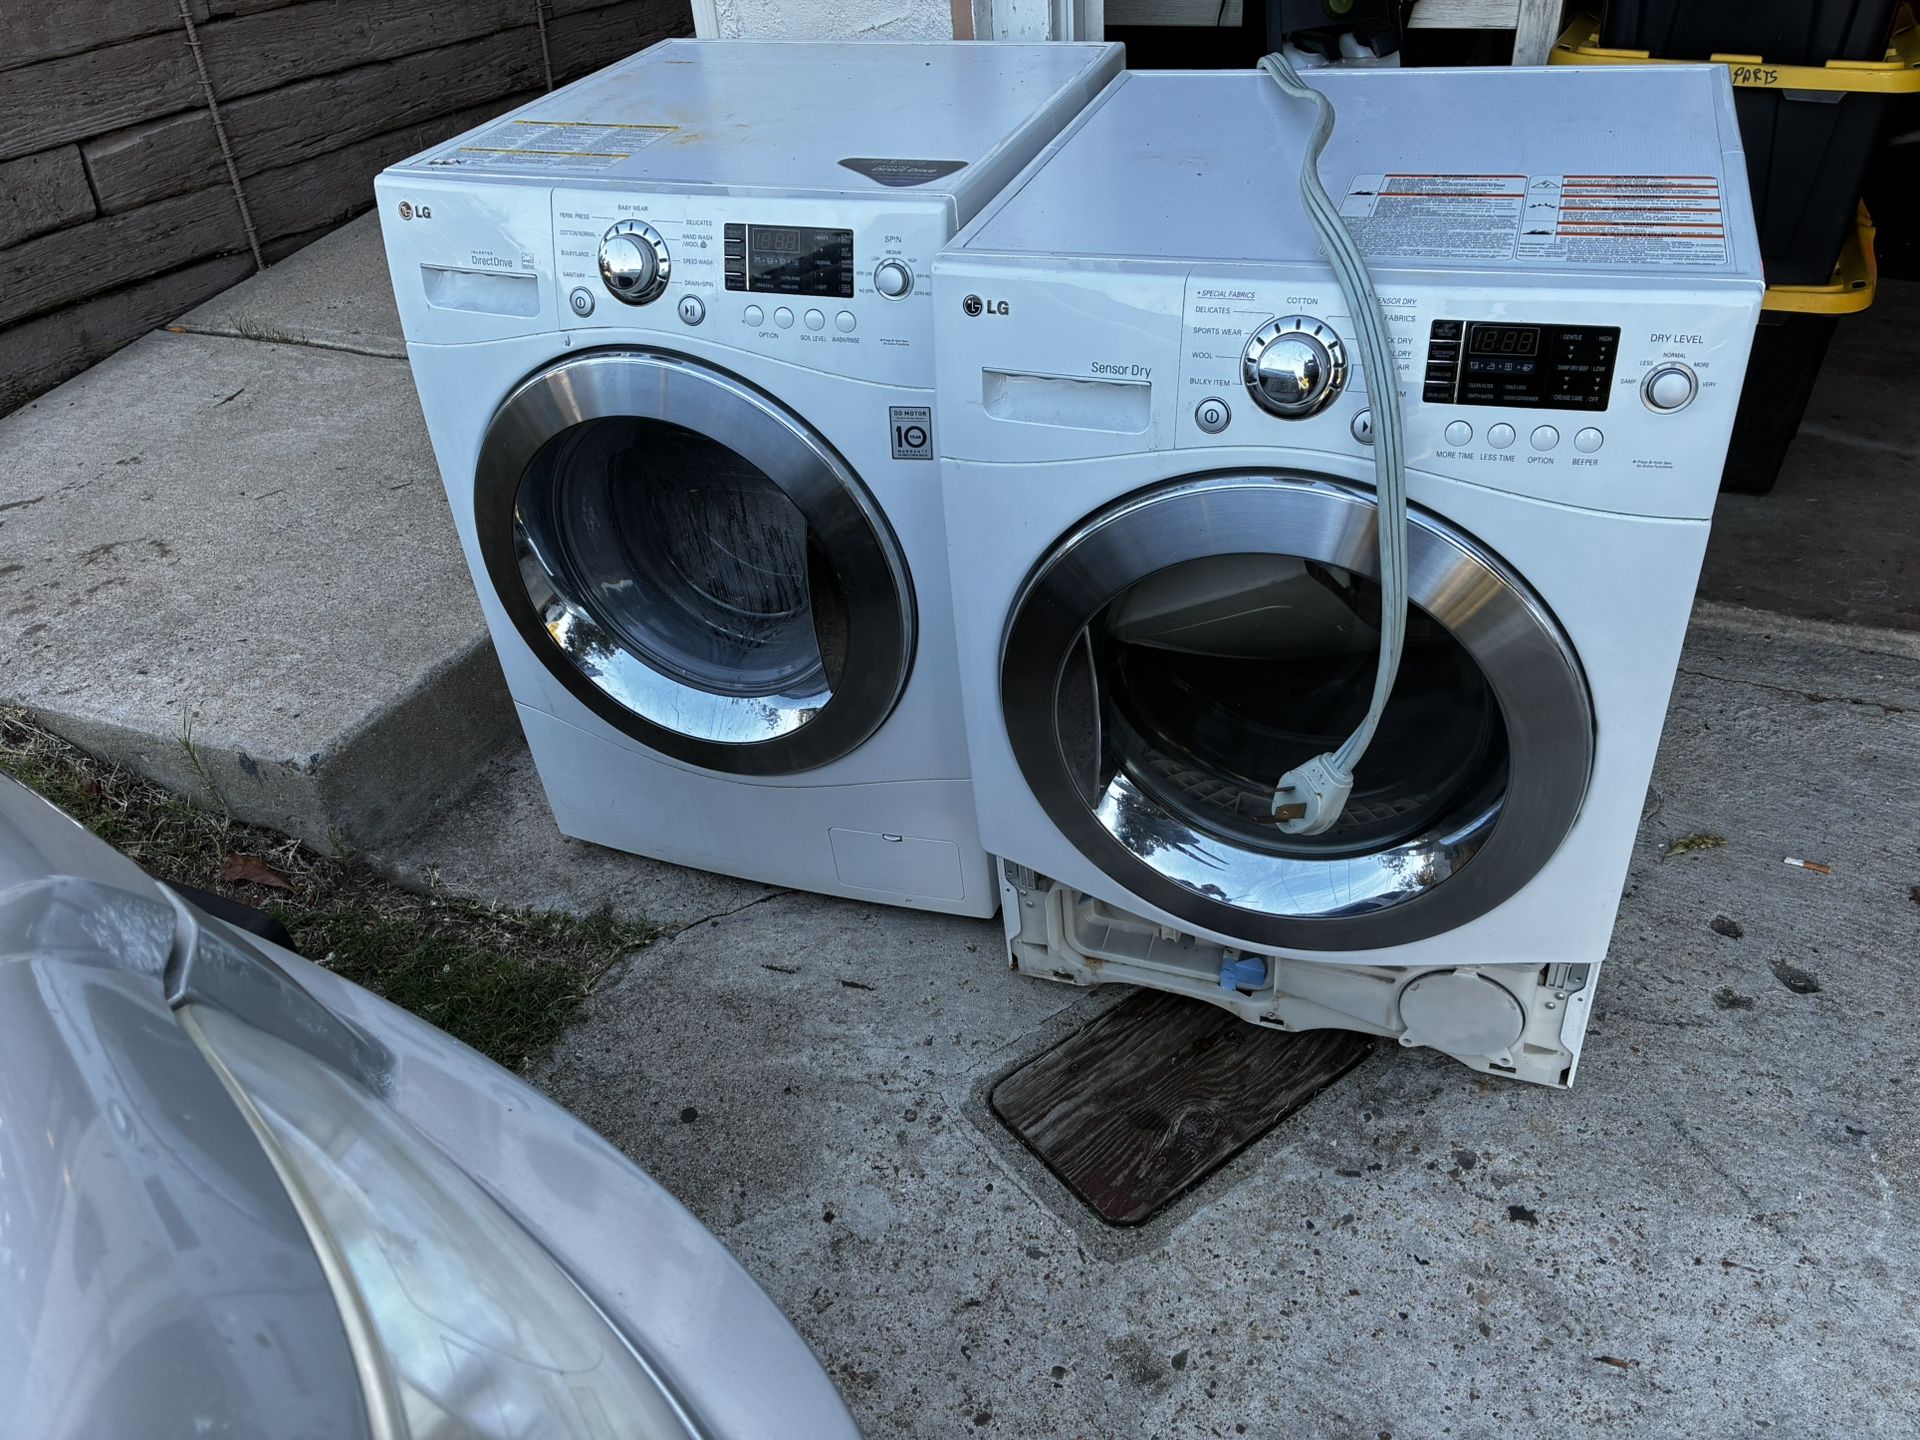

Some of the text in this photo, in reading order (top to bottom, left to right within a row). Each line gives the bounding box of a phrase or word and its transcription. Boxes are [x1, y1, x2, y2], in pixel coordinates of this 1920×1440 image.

[1732, 67, 1778, 84] PARTS
[415, 205, 431, 219] LG
[1202, 290, 1227, 298] SPECIAL
[1287, 297, 1318, 305] COTTON
[1377, 297, 1401, 305] ENSOR
[987, 300, 1009, 315] LG
[1384, 314, 1416, 322] FABRICS
[1193, 327, 1242, 336] SPORTS WEAR
[1650, 334, 1704, 344] DRY LEVEL
[1091, 361, 1152, 379] Sensor Dry
[896, 426, 927, 448] 10
[1436, 451, 1474, 460] MORE TIME
[1480, 453, 1516, 462] LESS TIME
[1527, 456, 1554, 465] OPTION
[1572, 458, 1598, 466] BEEPER
